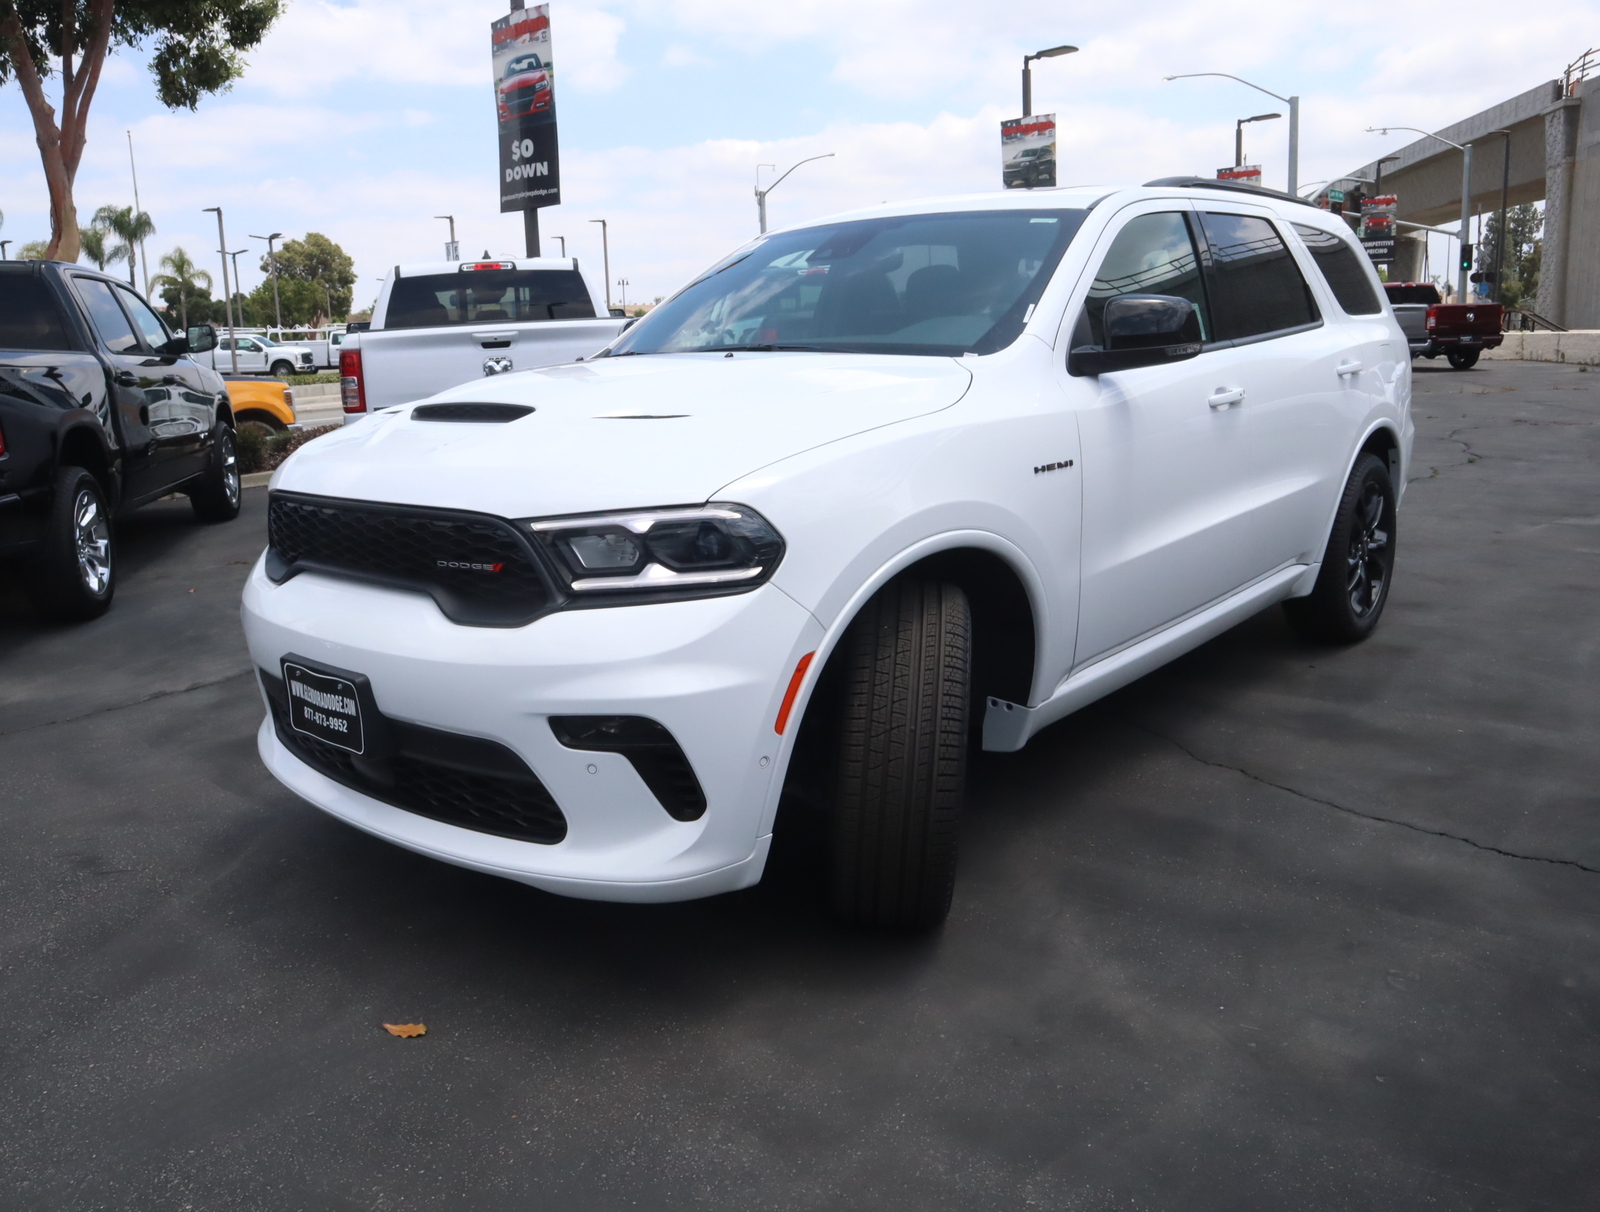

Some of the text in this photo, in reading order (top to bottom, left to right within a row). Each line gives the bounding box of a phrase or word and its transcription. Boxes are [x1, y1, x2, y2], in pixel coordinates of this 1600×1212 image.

[512, 139, 534, 161] $0
[505, 161, 549, 183] DOWN
[1034, 459, 1074, 474] HEMI
[437, 560, 494, 571] DODGE
[304, 706, 348, 733] 877-873-9952
